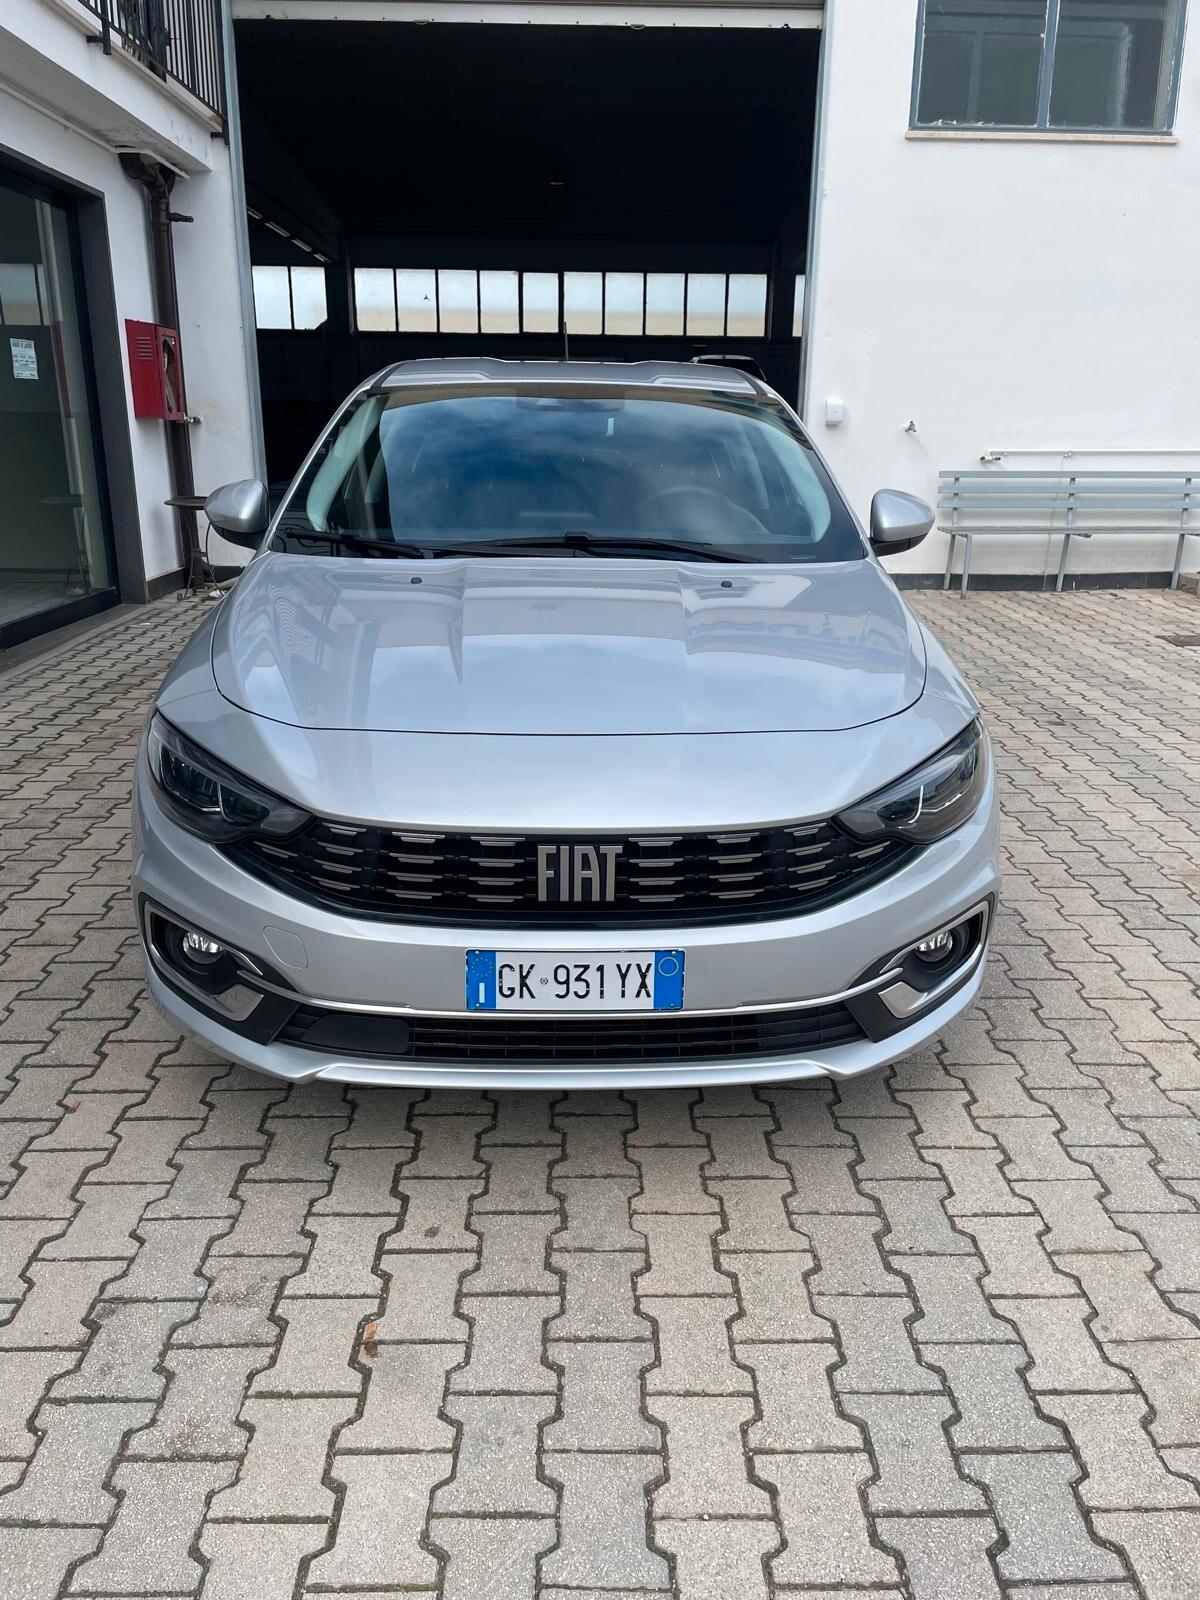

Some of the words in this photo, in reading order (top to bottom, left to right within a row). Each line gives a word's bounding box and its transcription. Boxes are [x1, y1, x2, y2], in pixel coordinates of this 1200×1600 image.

[537, 844, 623, 902] FIAT
[478, 982, 486, 1004] I
[498, 963, 536, 999] GK
